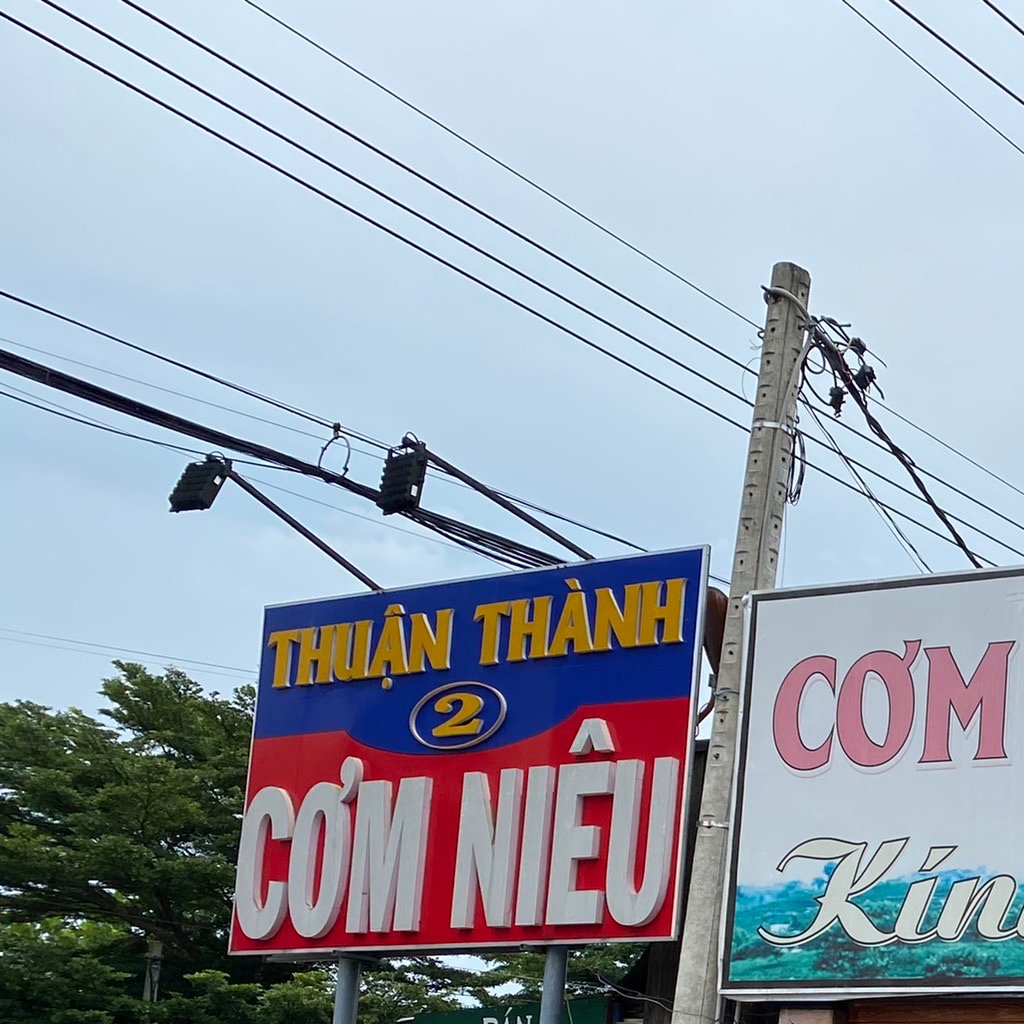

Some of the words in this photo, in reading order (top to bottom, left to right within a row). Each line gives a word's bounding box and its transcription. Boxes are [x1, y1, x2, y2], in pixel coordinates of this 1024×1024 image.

[267, 604, 455, 690] THUẬN
[474, 577, 689, 665] THÀNH
[431, 692, 485, 738] 2
[772, 639, 1016, 773] CƠM
[236, 756, 434, 941] CƠM
[450, 717, 680, 930] NIÊU
